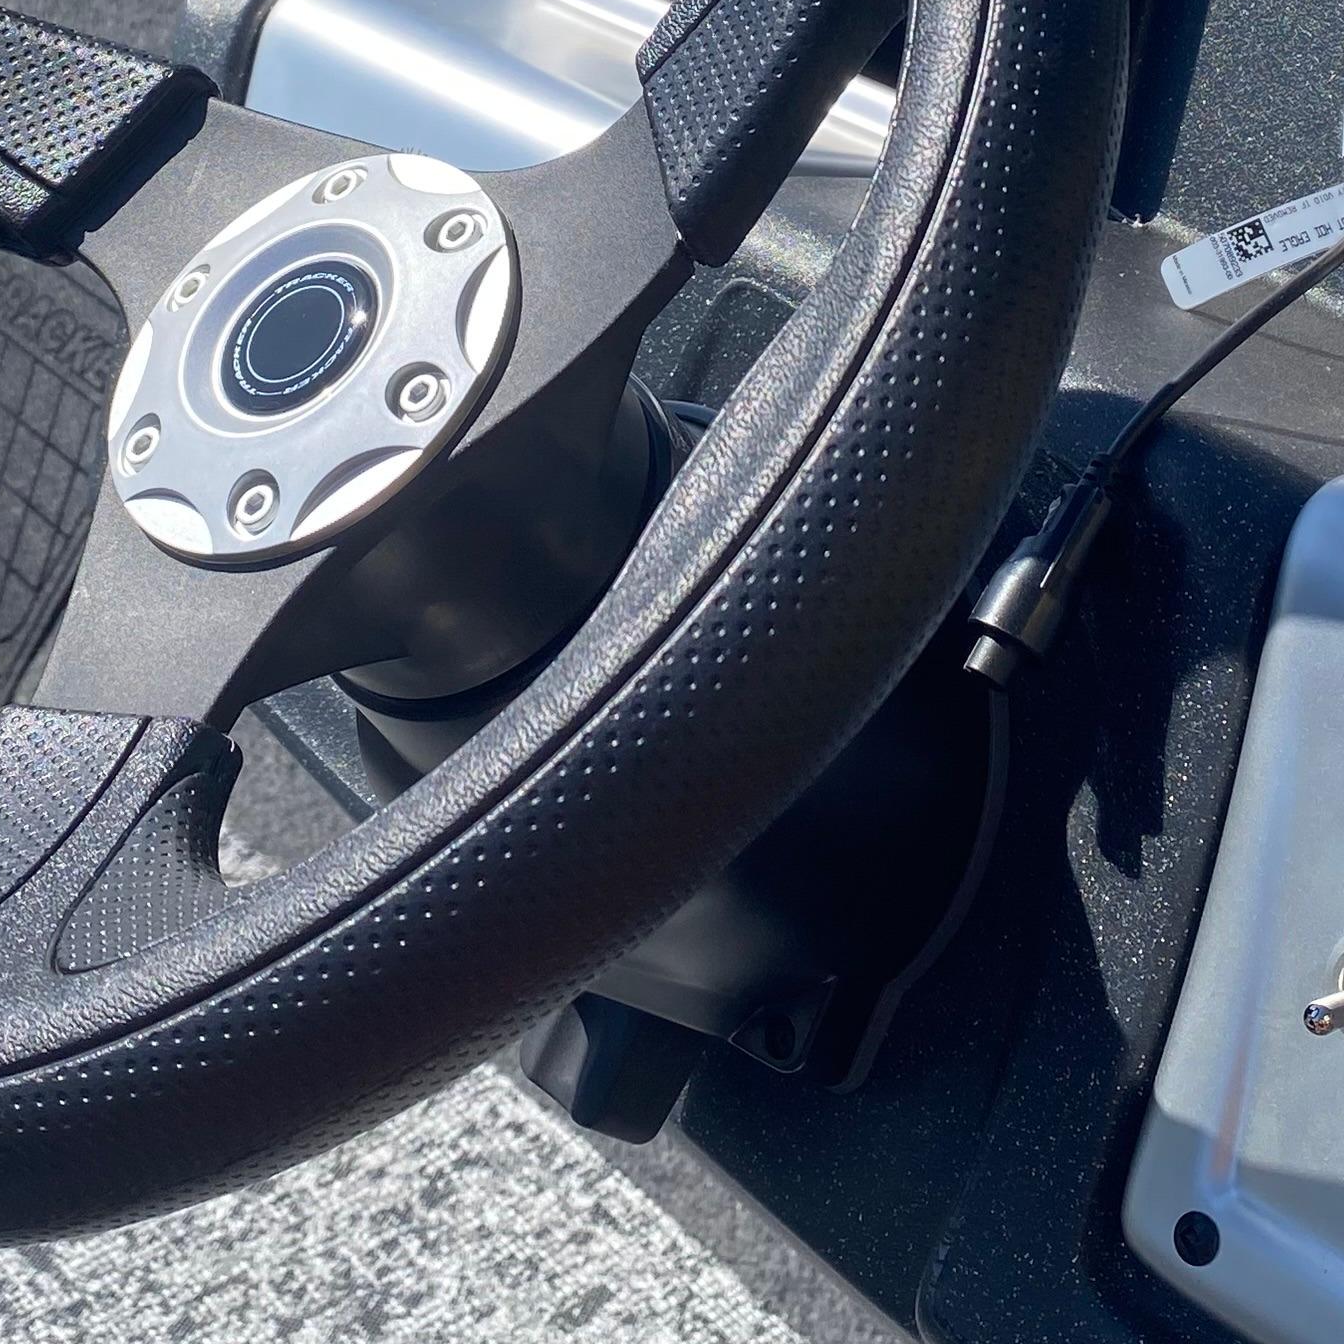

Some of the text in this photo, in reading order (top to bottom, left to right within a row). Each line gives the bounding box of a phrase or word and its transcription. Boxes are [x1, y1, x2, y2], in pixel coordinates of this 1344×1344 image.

[1302, 199, 1312, 209] IF
[1313, 193, 1334, 204] VOID
[1263, 206, 1297, 224] REMOVED
[1279, 230, 1311, 252] EAGLE
[1314, 223, 1334, 239] HDI
[274, 272, 354, 294] TRACKER
[233, 318, 257, 395] TRACKER
[283, 325, 355, 395] RACKER
